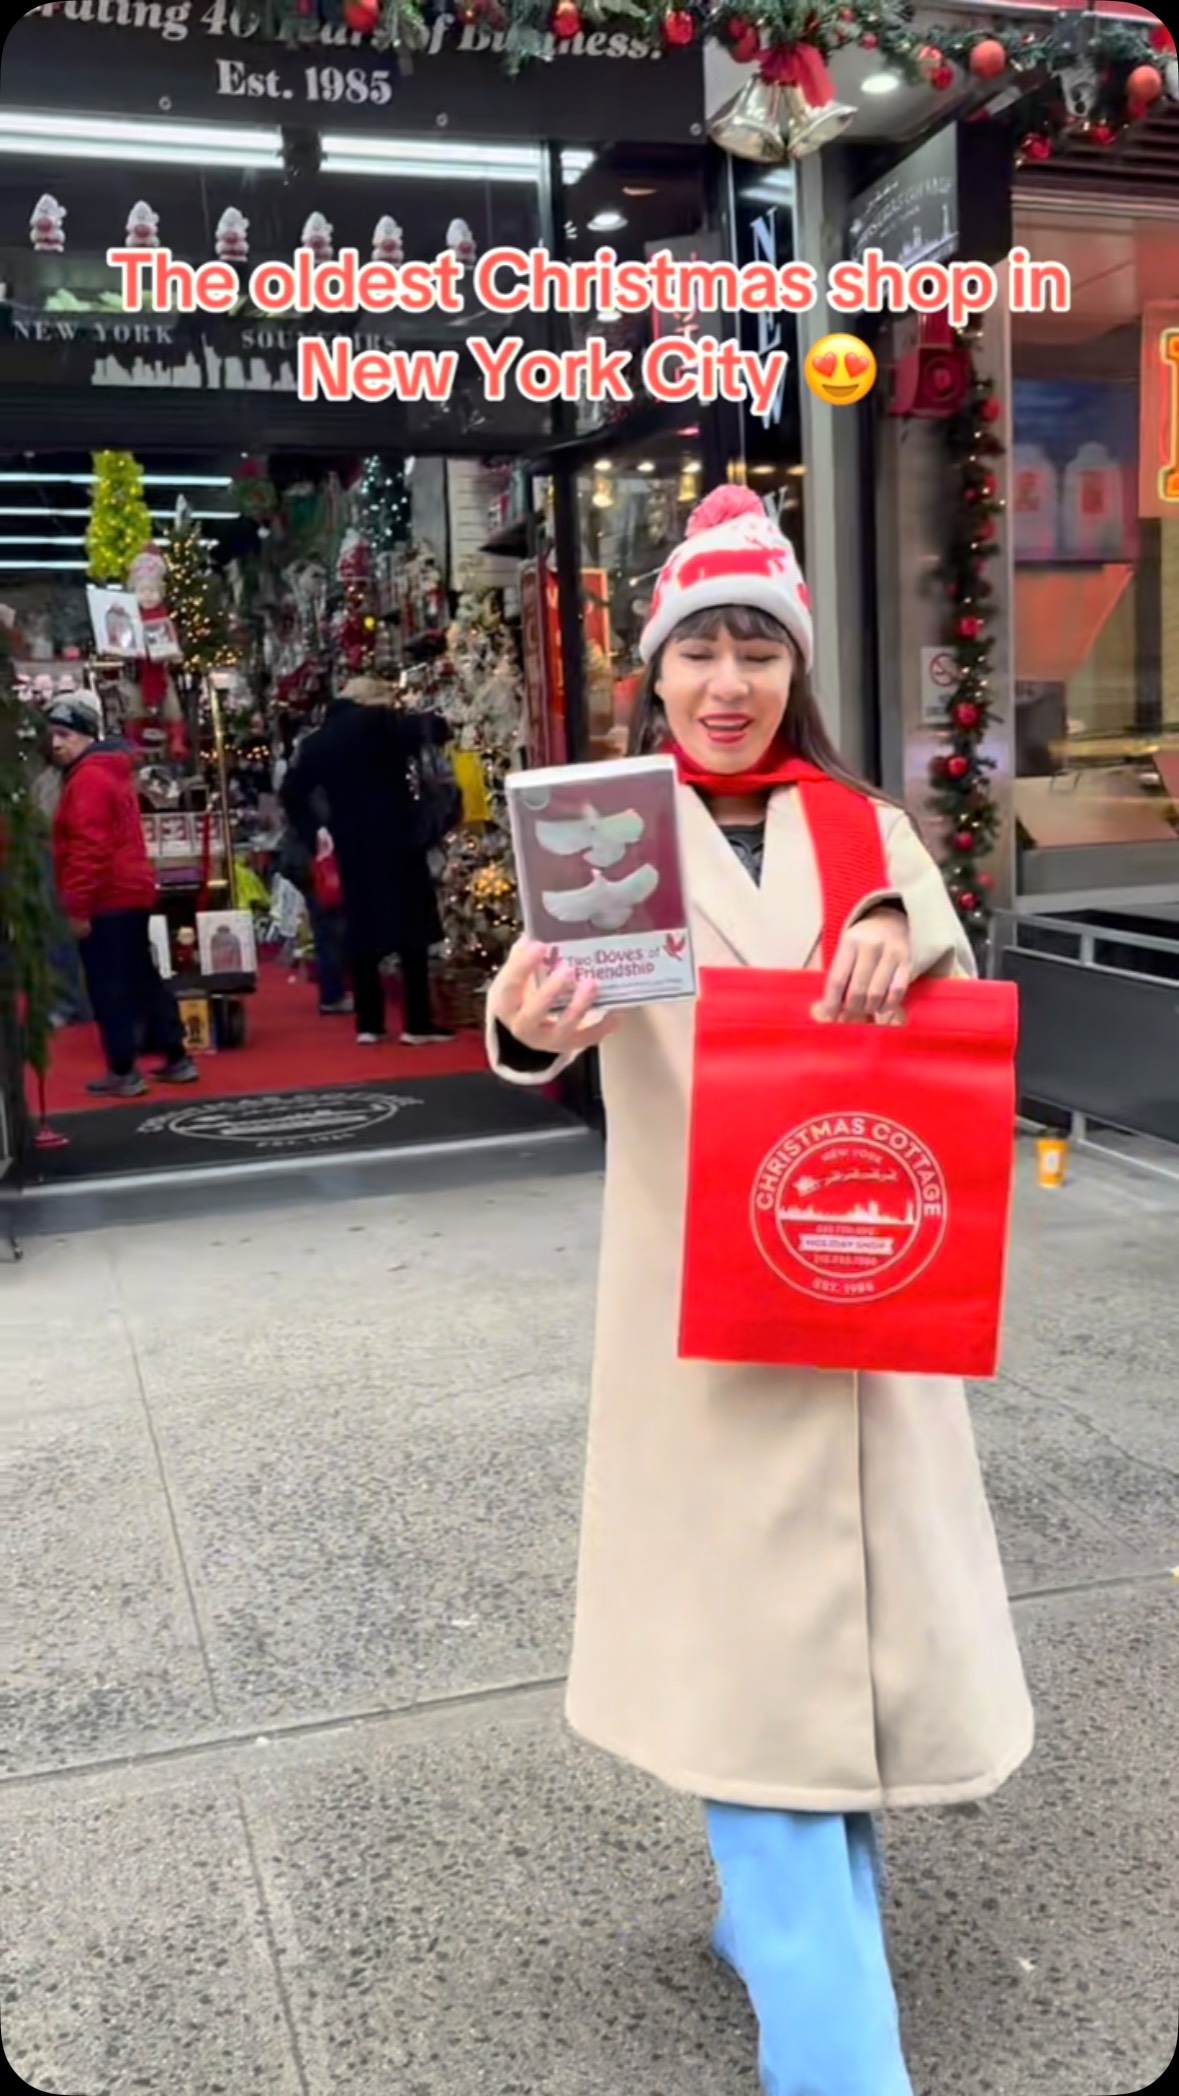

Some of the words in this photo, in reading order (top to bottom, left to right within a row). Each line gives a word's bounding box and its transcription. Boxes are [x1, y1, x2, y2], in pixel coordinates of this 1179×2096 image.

[215, 58, 293, 99] Est.
[305, 66, 393, 105] 1985
[13, 320, 78, 342] NEW
[97, 324, 174, 344] YORK
[241, 328, 397, 350] SOUIRS
[567, 955, 592, 967] Two
[595, 949, 644, 964] Doves
[649, 947, 661, 959] of
[574, 961, 656, 981] Friendship
[756, 1117, 866, 1211] CHRISTMAS
[872, 1123, 942, 1217] COTTAGE
[821, 1149, 849, 1162] NEW
[851, 1149, 884, 1165] YORK
